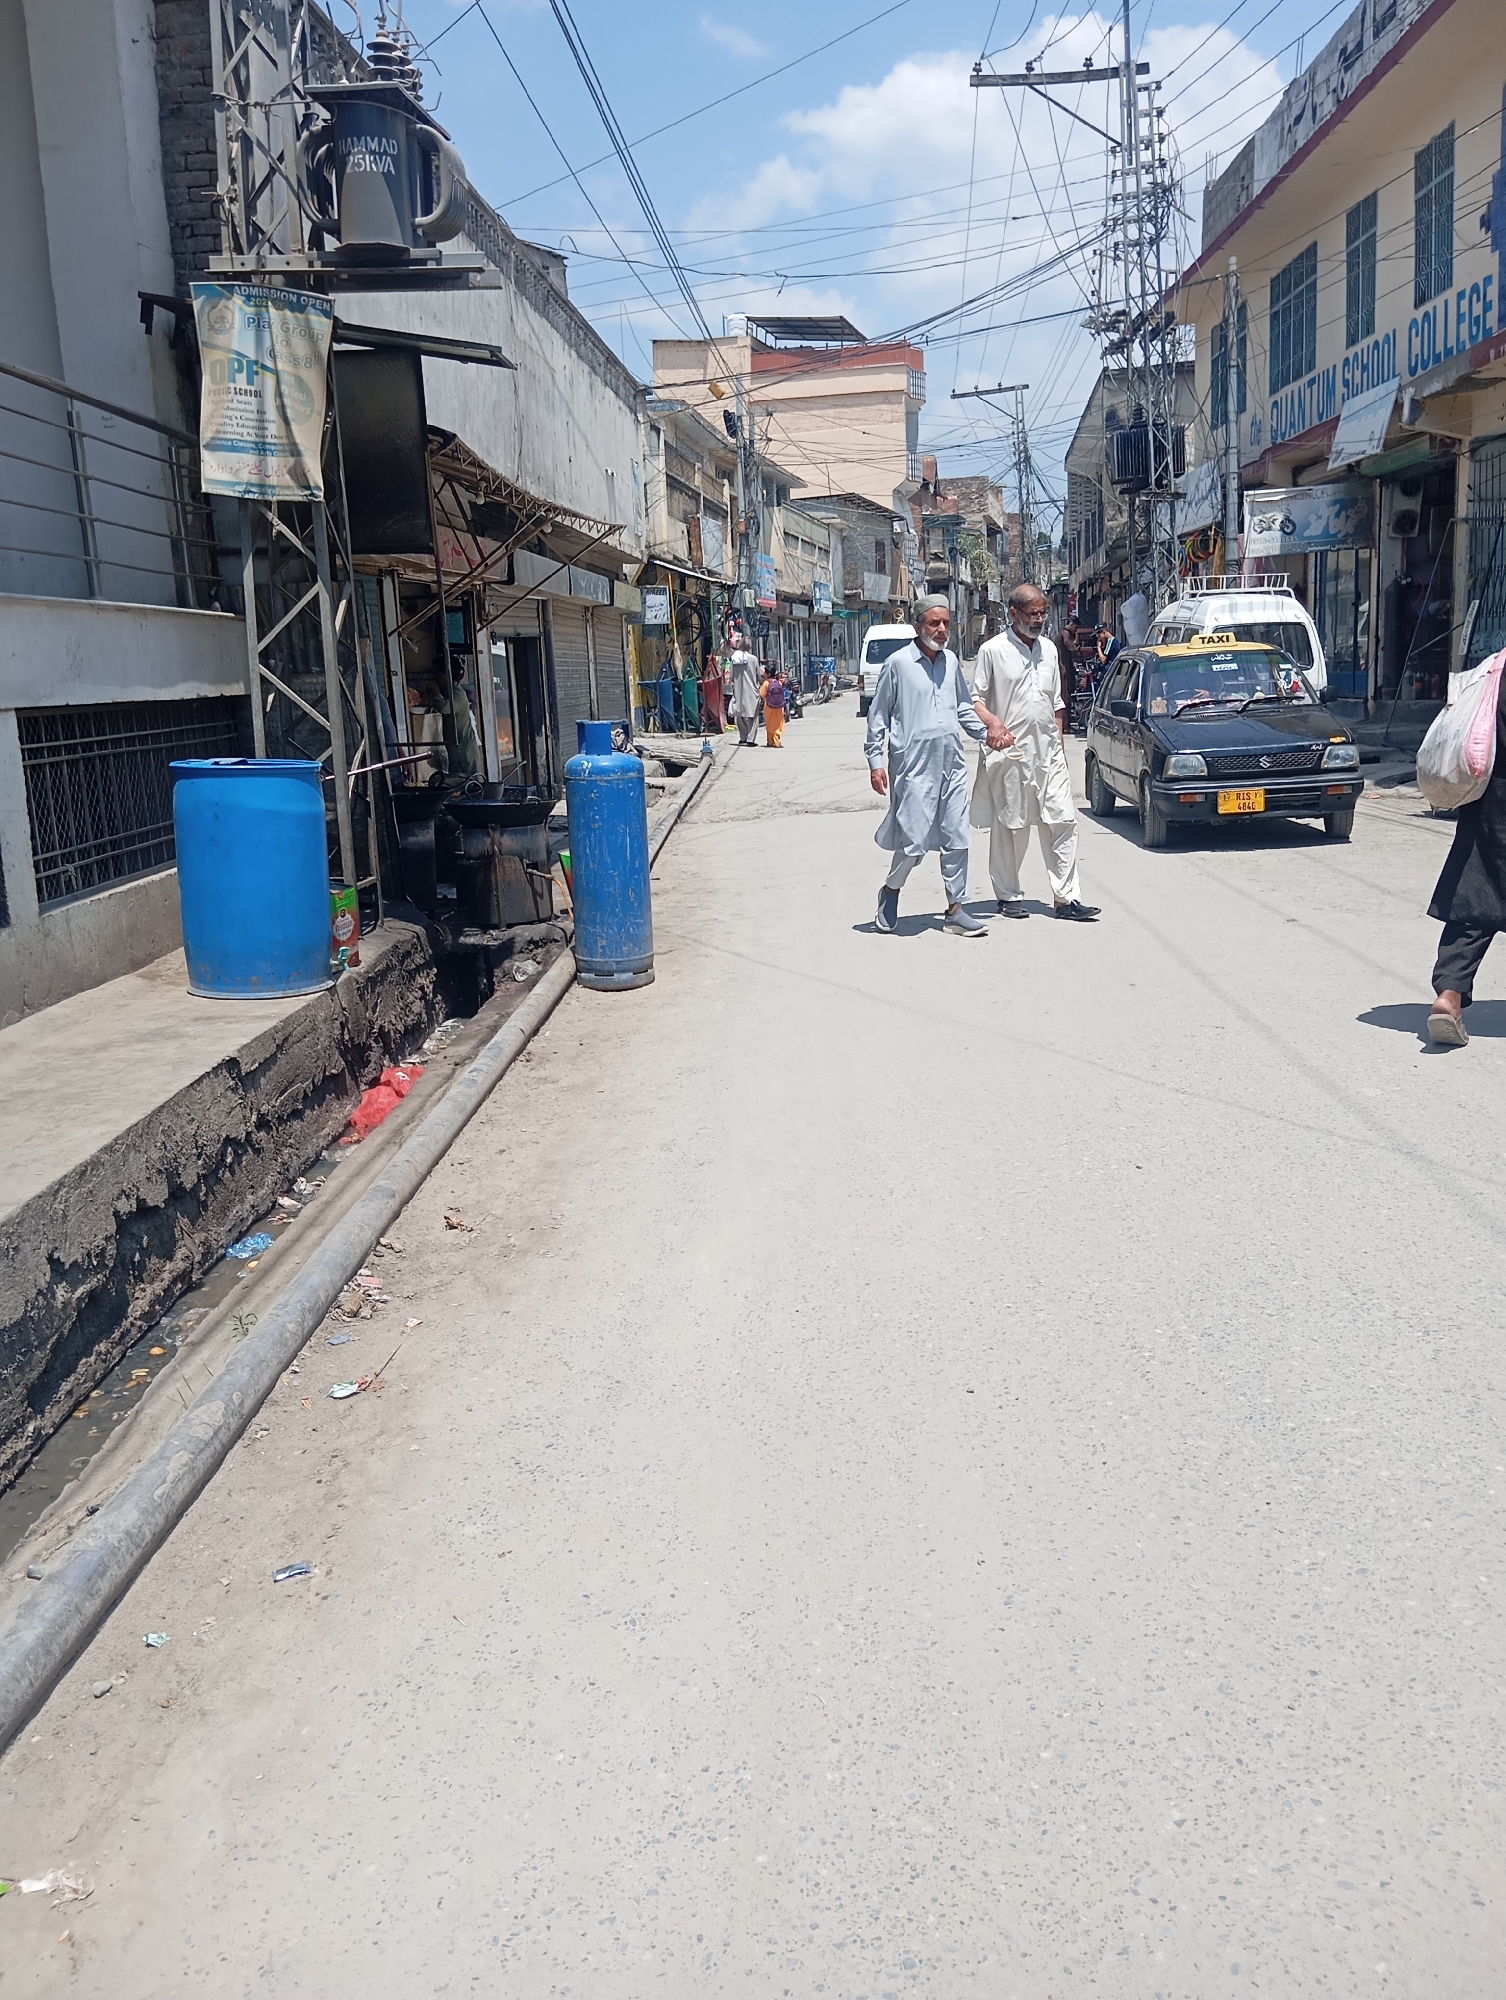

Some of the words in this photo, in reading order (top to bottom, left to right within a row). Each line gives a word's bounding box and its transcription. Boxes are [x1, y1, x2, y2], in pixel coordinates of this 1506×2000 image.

[339, 136, 398, 155] HAMMAD
[346, 153, 396, 175] 25KVA
[233, 285, 297, 303] ADMISSION
[300, 296, 331, 311] OPEN
[274, 332, 291, 348] to
[279, 320, 326, 344] Group
[266, 346, 302, 368] Cass
[1270, 364, 1337, 446] QUANTUM
[1341, 328, 1400, 402] SCHOOL
[1408, 274, 1494, 378] COLLEGE
[210, 357, 260, 387] OPF
[233, 386, 263, 399] SCHOOL
[236, 399, 253, 407] Seats
[236, 422, 269, 431] Education
[239, 414, 277, 424] Concession
[254, 432, 269, 440] Your
[1198, 634, 1230, 645] TAXI
